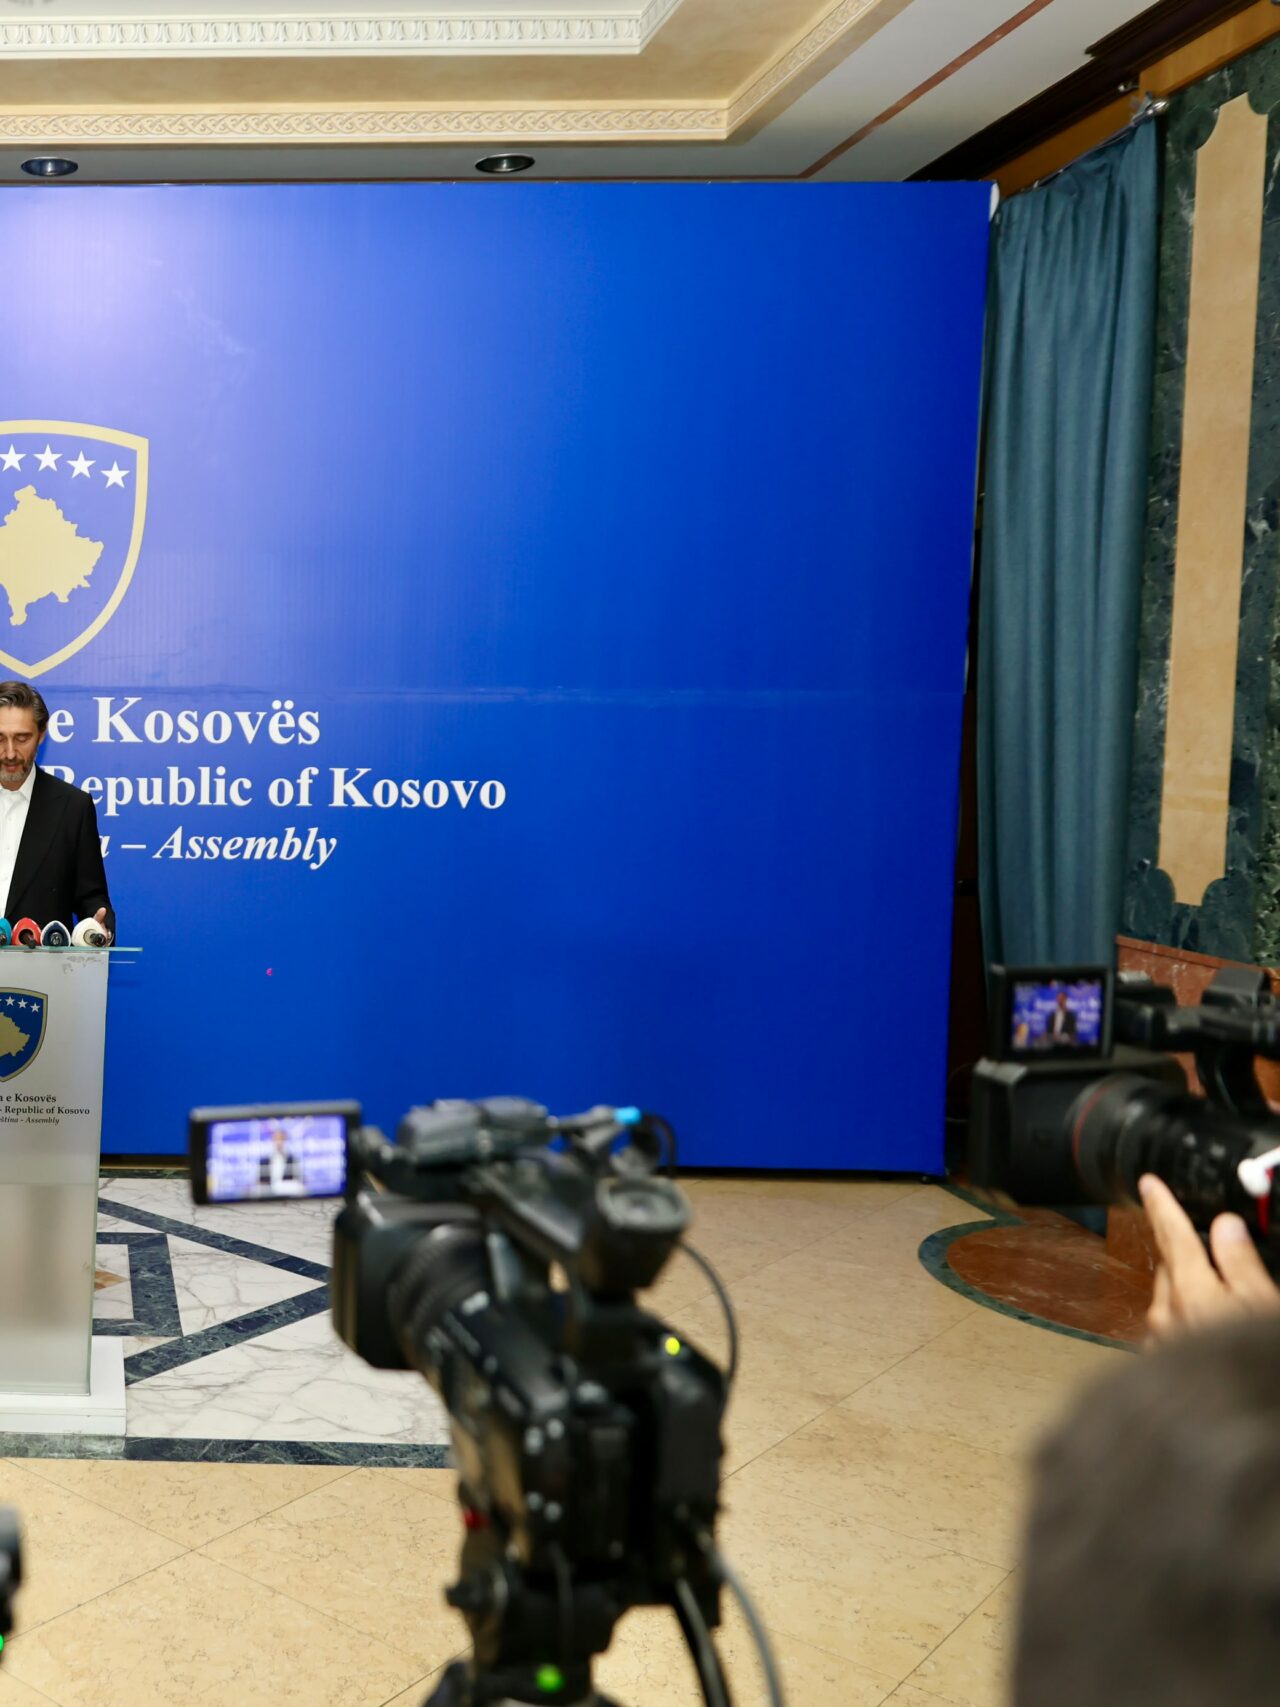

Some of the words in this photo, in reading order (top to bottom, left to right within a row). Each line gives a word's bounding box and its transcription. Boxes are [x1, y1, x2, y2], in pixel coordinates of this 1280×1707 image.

[47, 709, 75, 743] e
[91, 696, 321, 745] Kosovës
[268, 766, 319, 807] of
[329, 767, 506, 809] Kosovo
[153, 825, 337, 870] Assembly
[4, 1105, 45, 1116] Republic
[45, 1105, 56, 1115] of
[57, 1106, 91, 1116] Kosovo
[14, 1093, 57, 1103] Kosovës
[24, 1116, 60, 1126] Assembly
